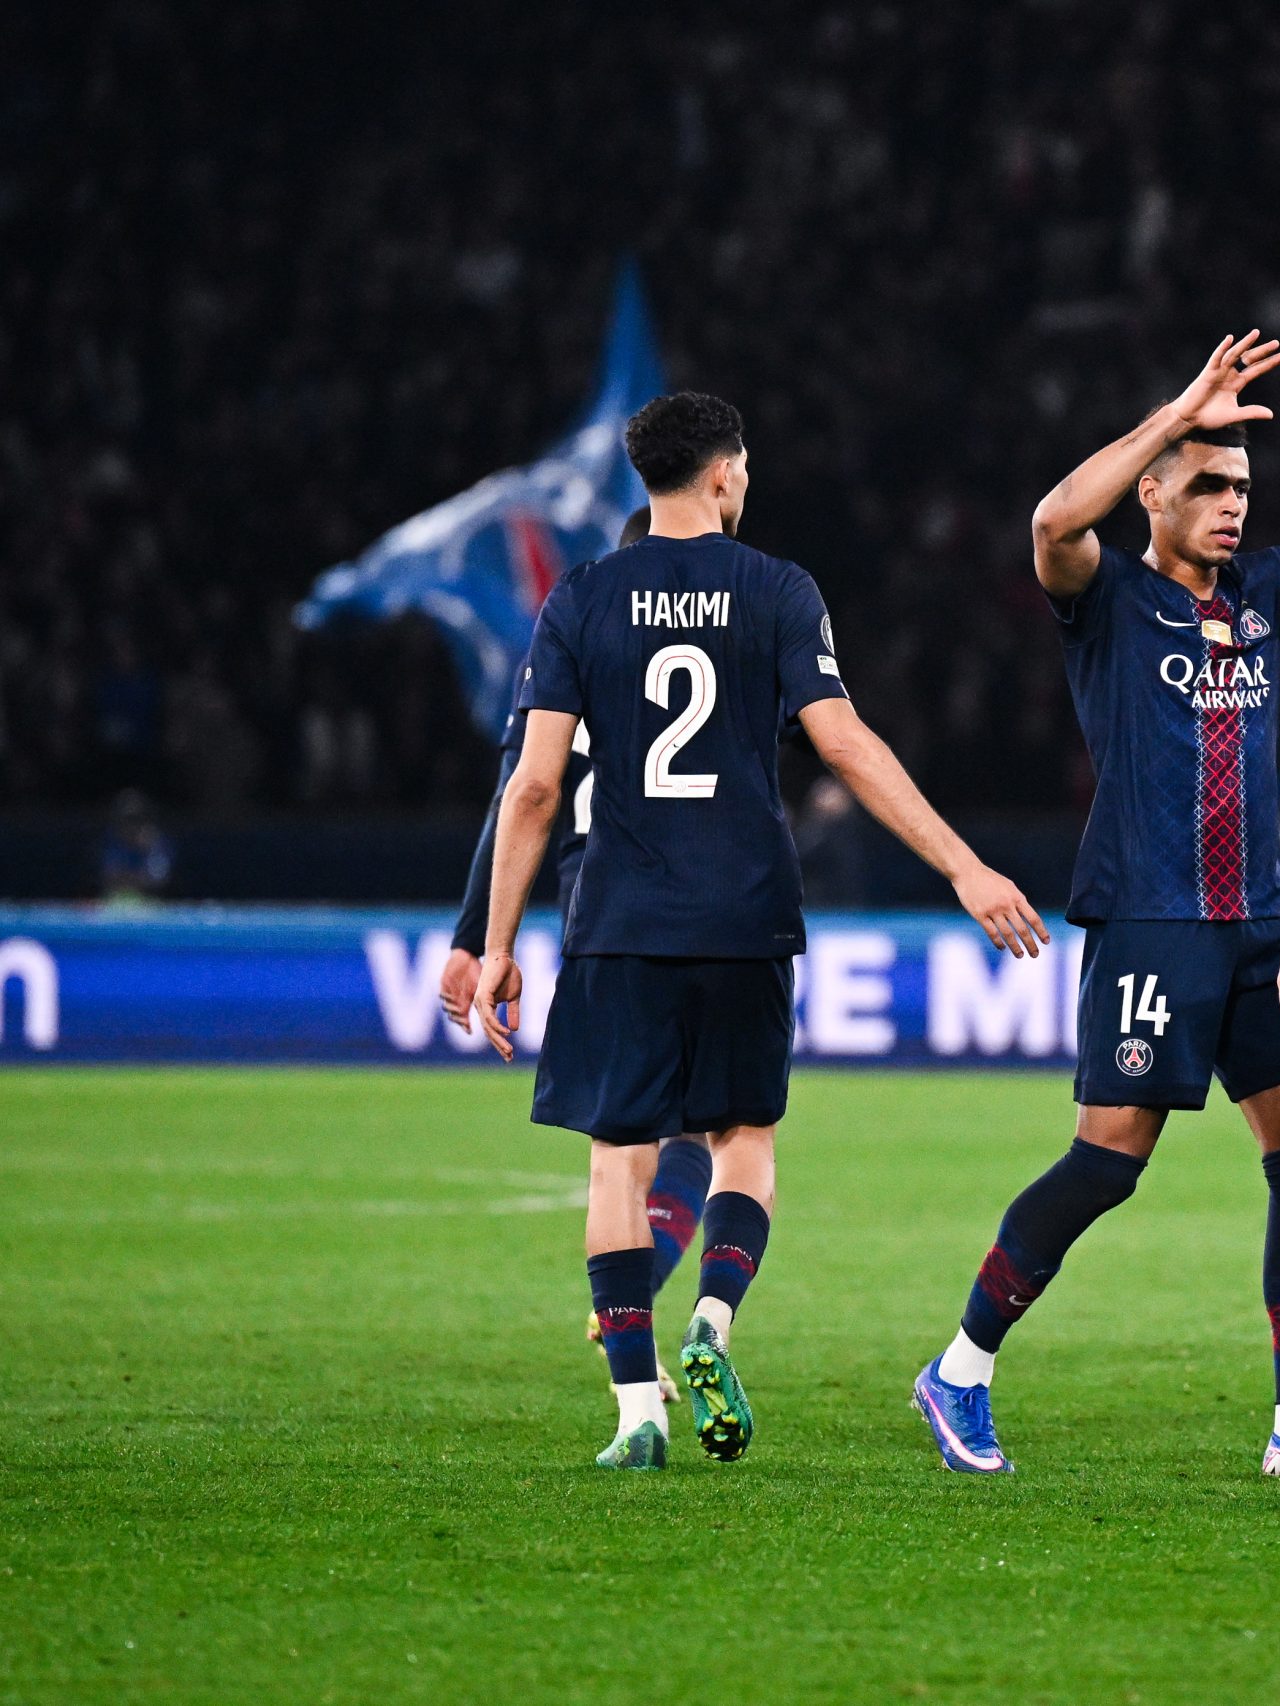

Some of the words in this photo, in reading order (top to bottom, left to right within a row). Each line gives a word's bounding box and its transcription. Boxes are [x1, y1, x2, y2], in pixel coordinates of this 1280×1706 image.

[631, 590, 731, 629] HAKIMI
[1160, 653, 1271, 695] QATAR
[644, 644, 719, 798] 2
[1117, 973, 1172, 1036] 14
[1122, 1041, 1148, 1051] PARIS
